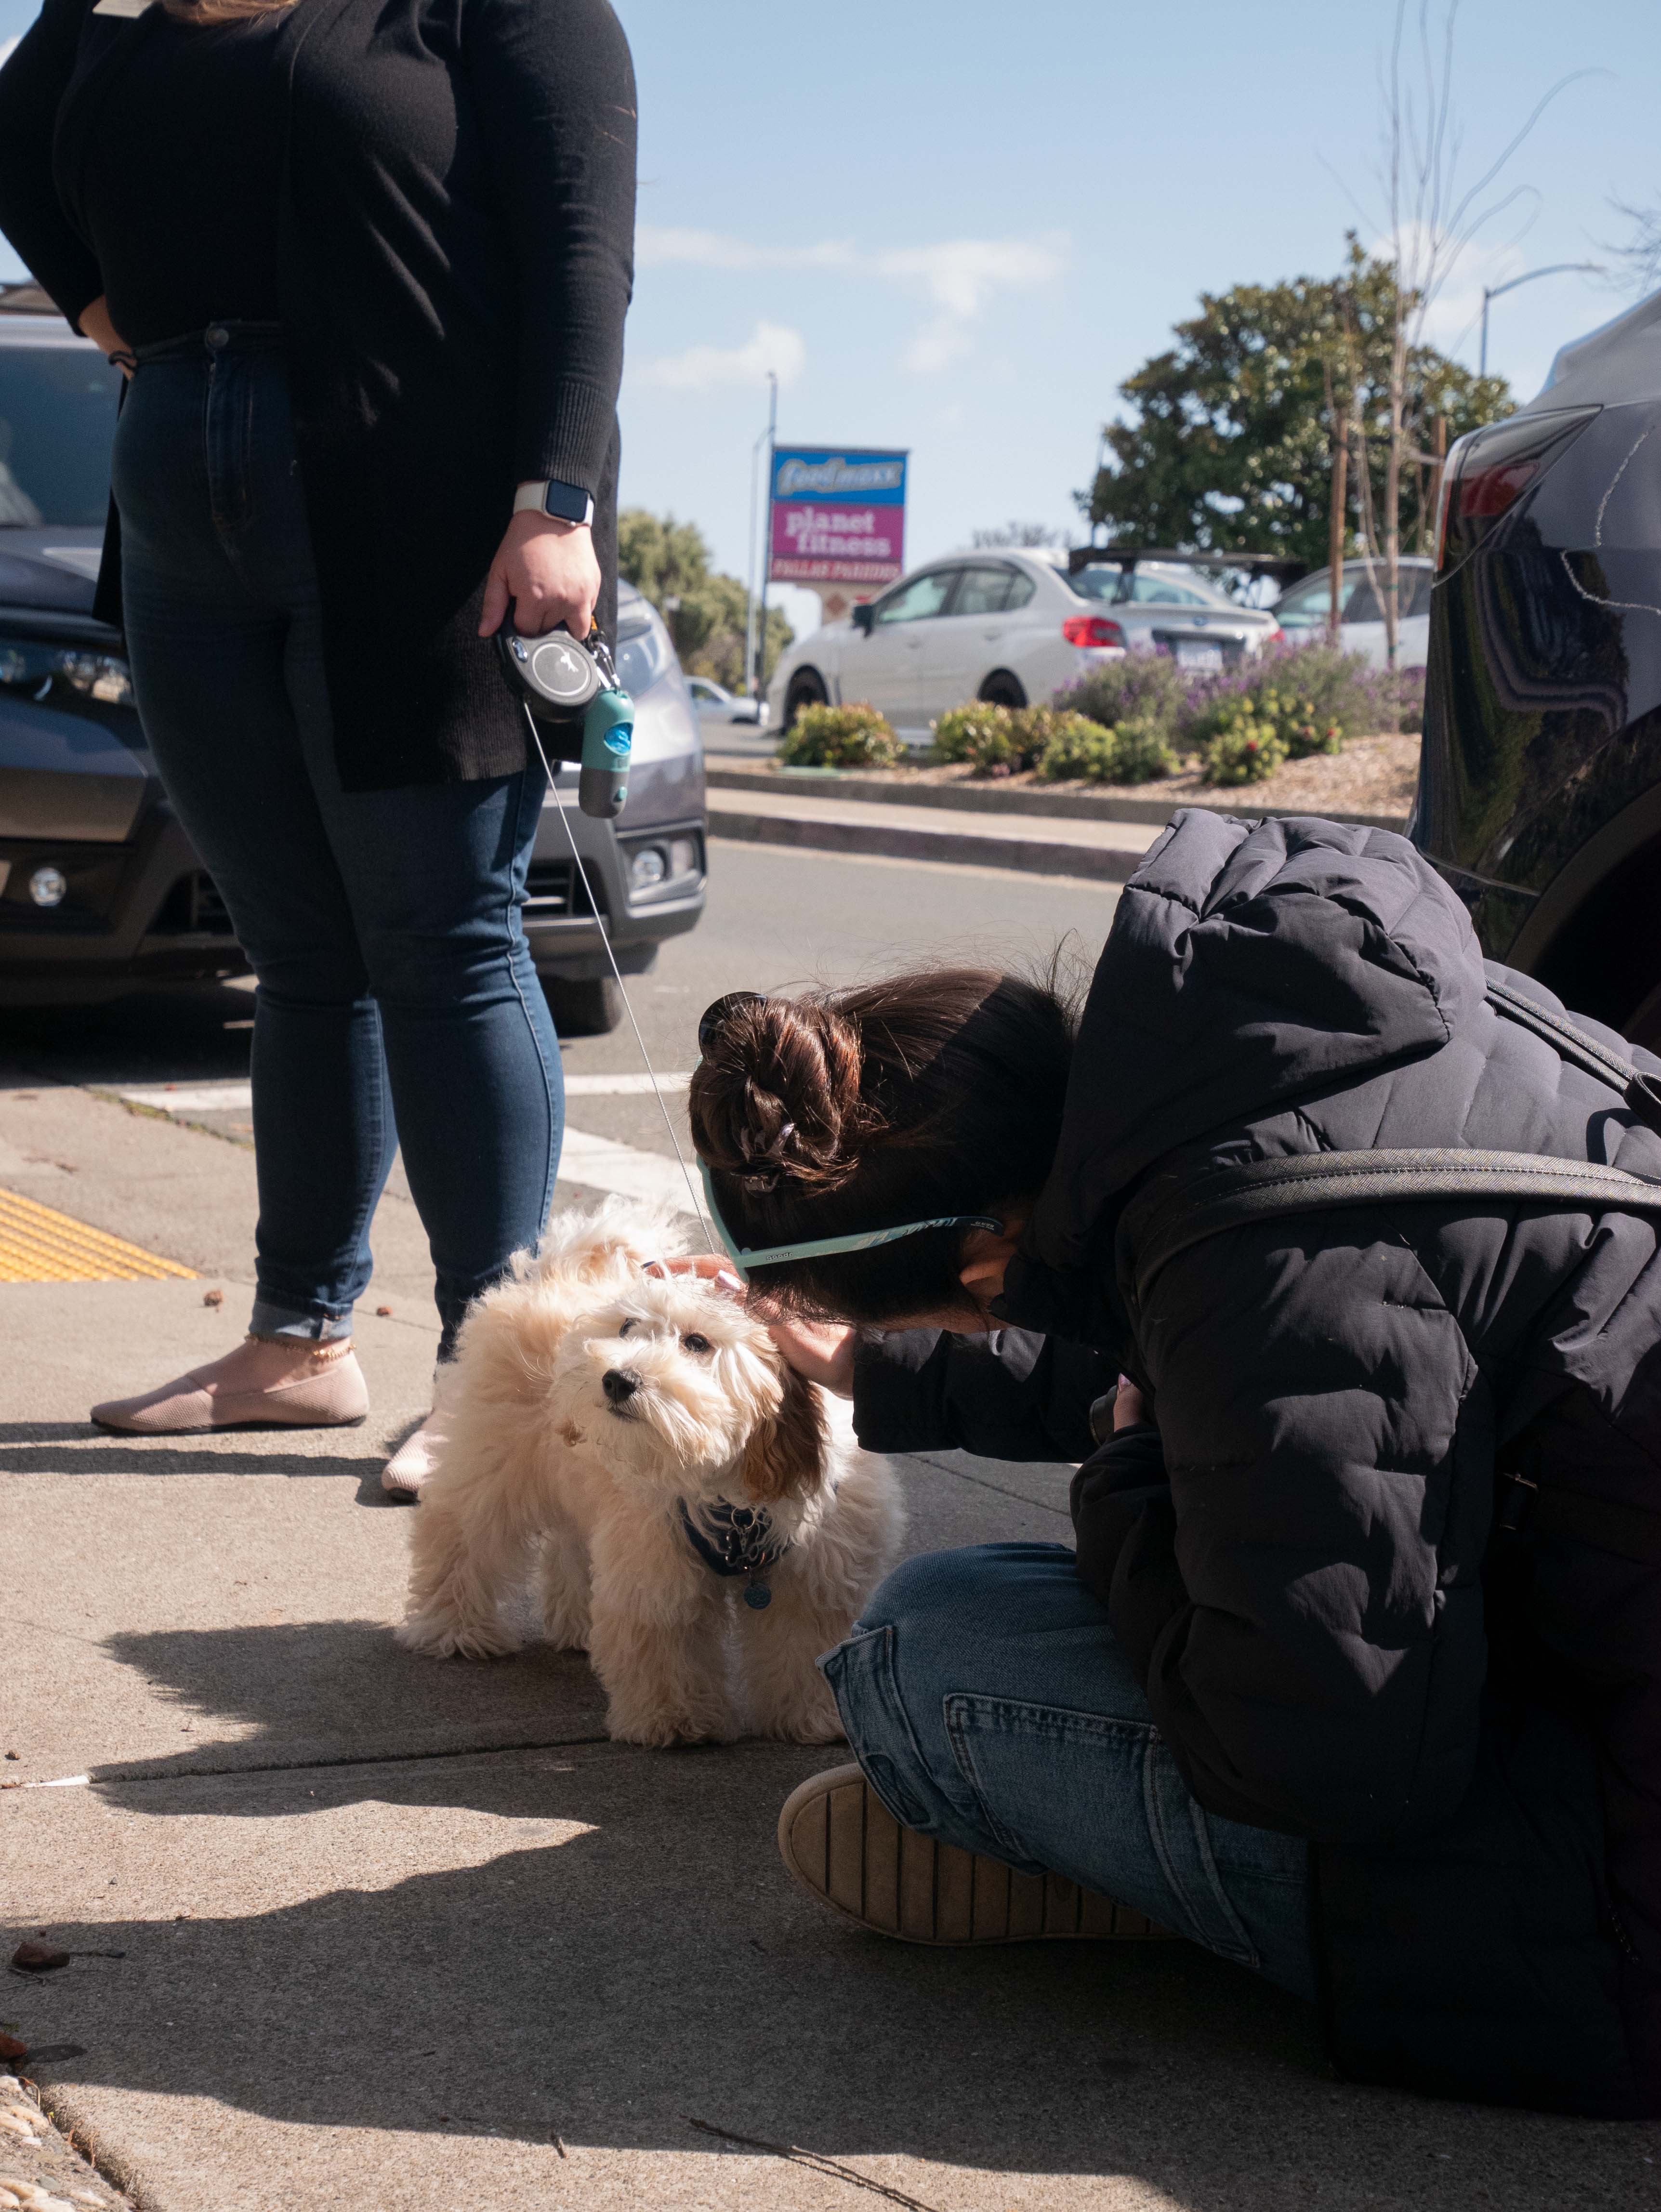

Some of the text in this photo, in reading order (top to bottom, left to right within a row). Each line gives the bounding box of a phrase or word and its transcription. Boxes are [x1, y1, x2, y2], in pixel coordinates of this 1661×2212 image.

[785, 505, 875, 537] planet
[796, 533, 891, 557] fitness
[766, 1252, 794, 1261] goodr
